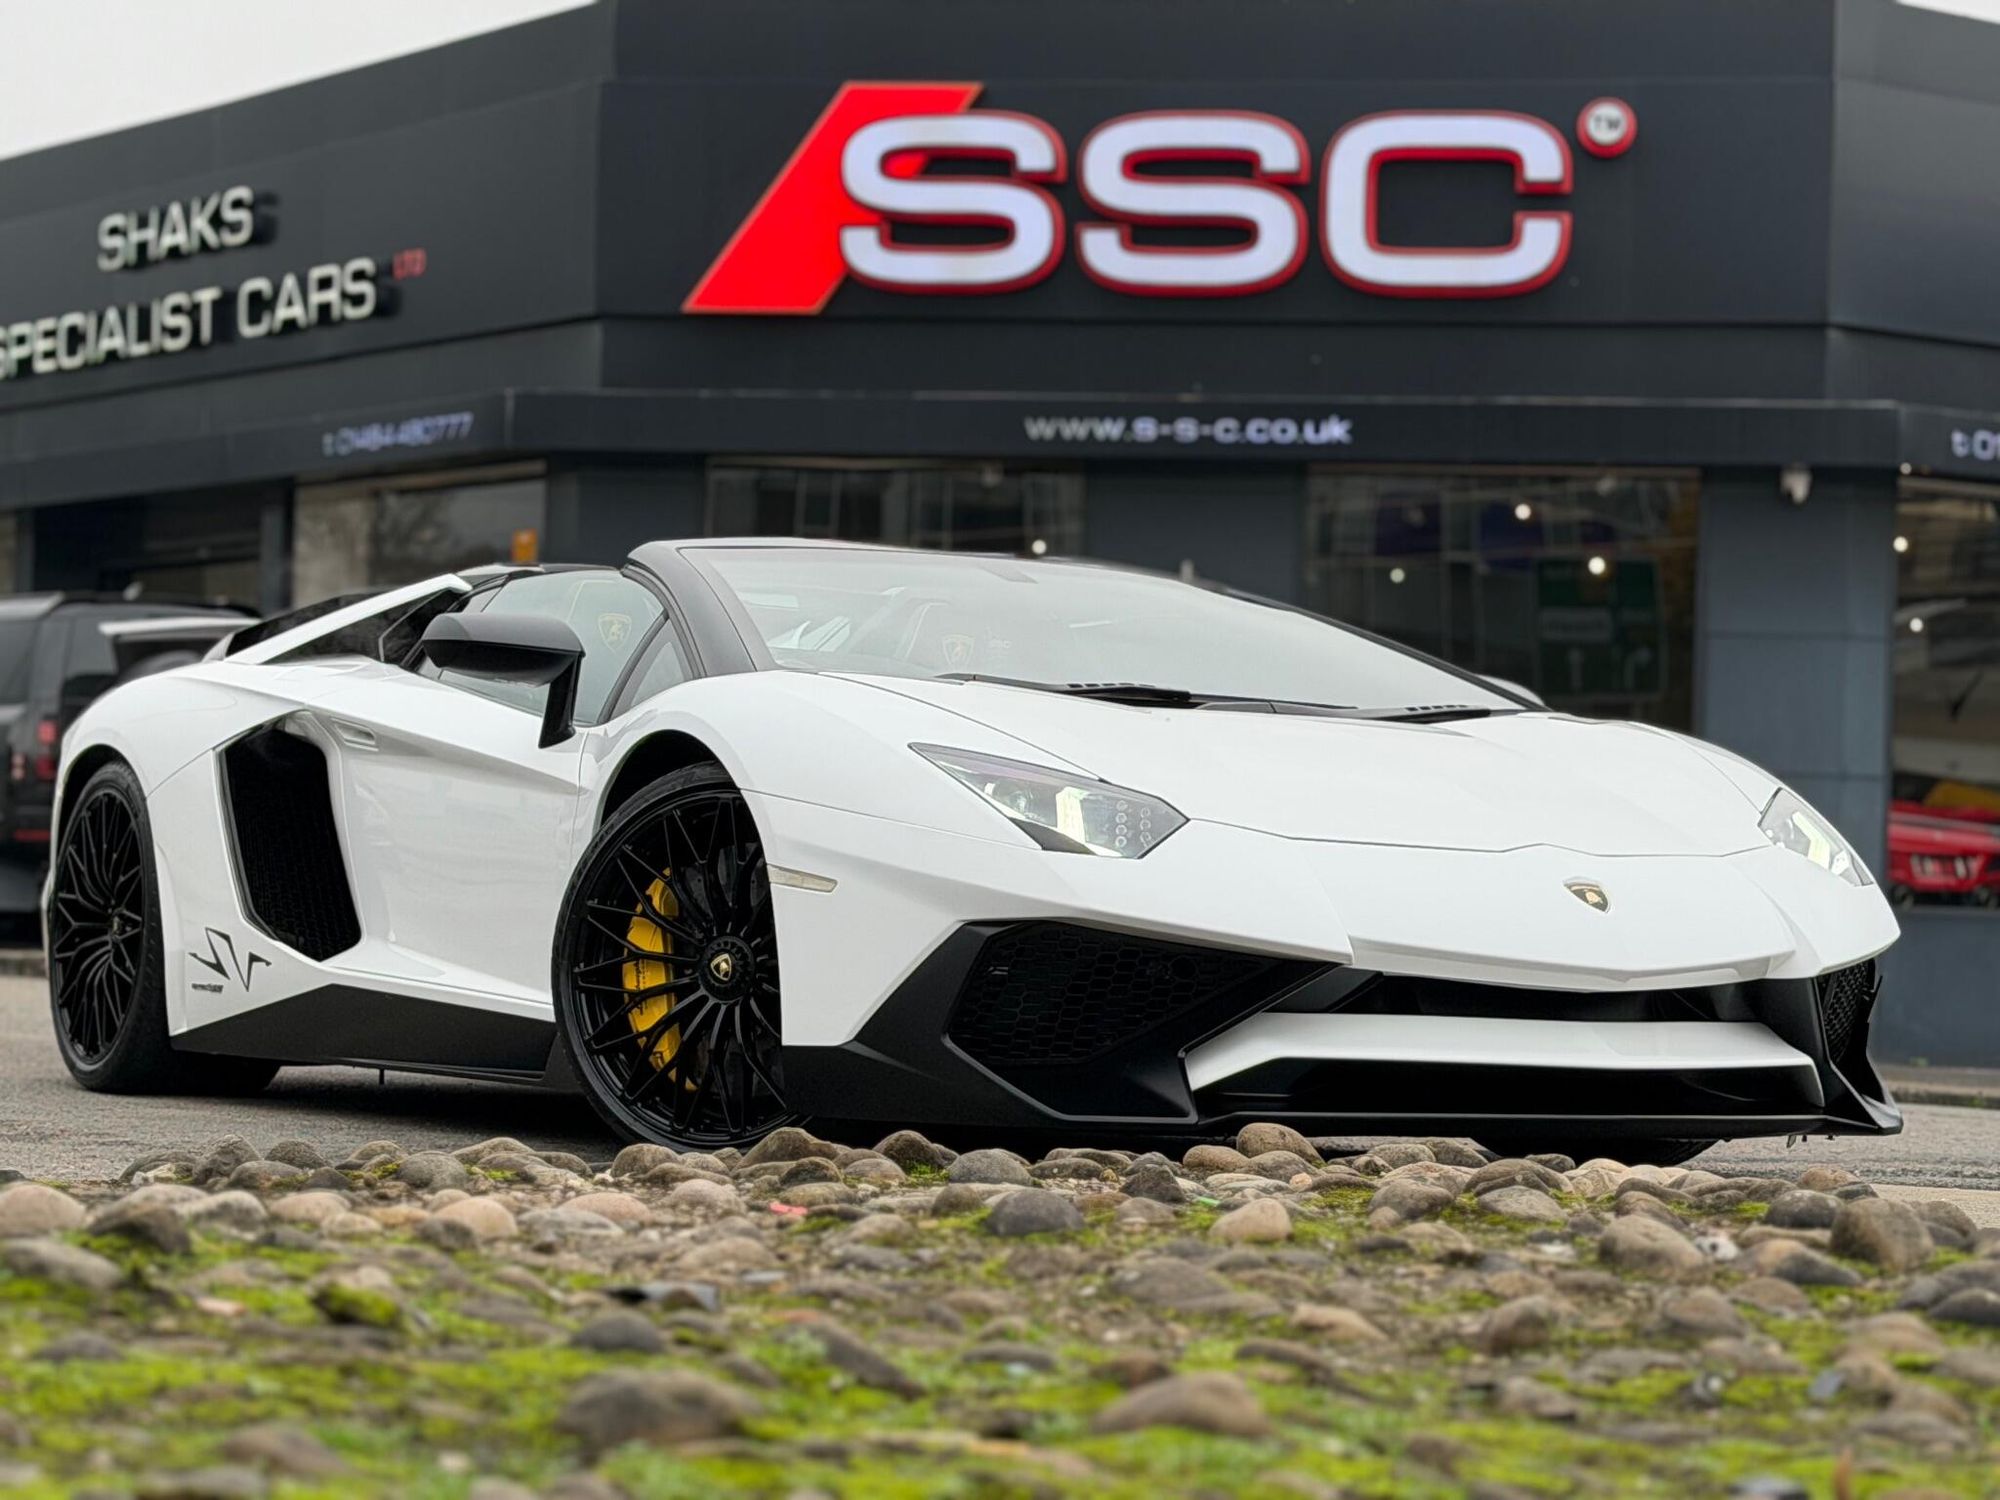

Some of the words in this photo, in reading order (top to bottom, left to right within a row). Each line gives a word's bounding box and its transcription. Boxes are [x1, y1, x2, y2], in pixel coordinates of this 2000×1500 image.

[98, 186, 253, 271] SHAKS
[840, 109, 1572, 297] SSC
[237, 258, 376, 339] CARS
[1024, 414, 1353, 444] www.s-s-c.co.uk
